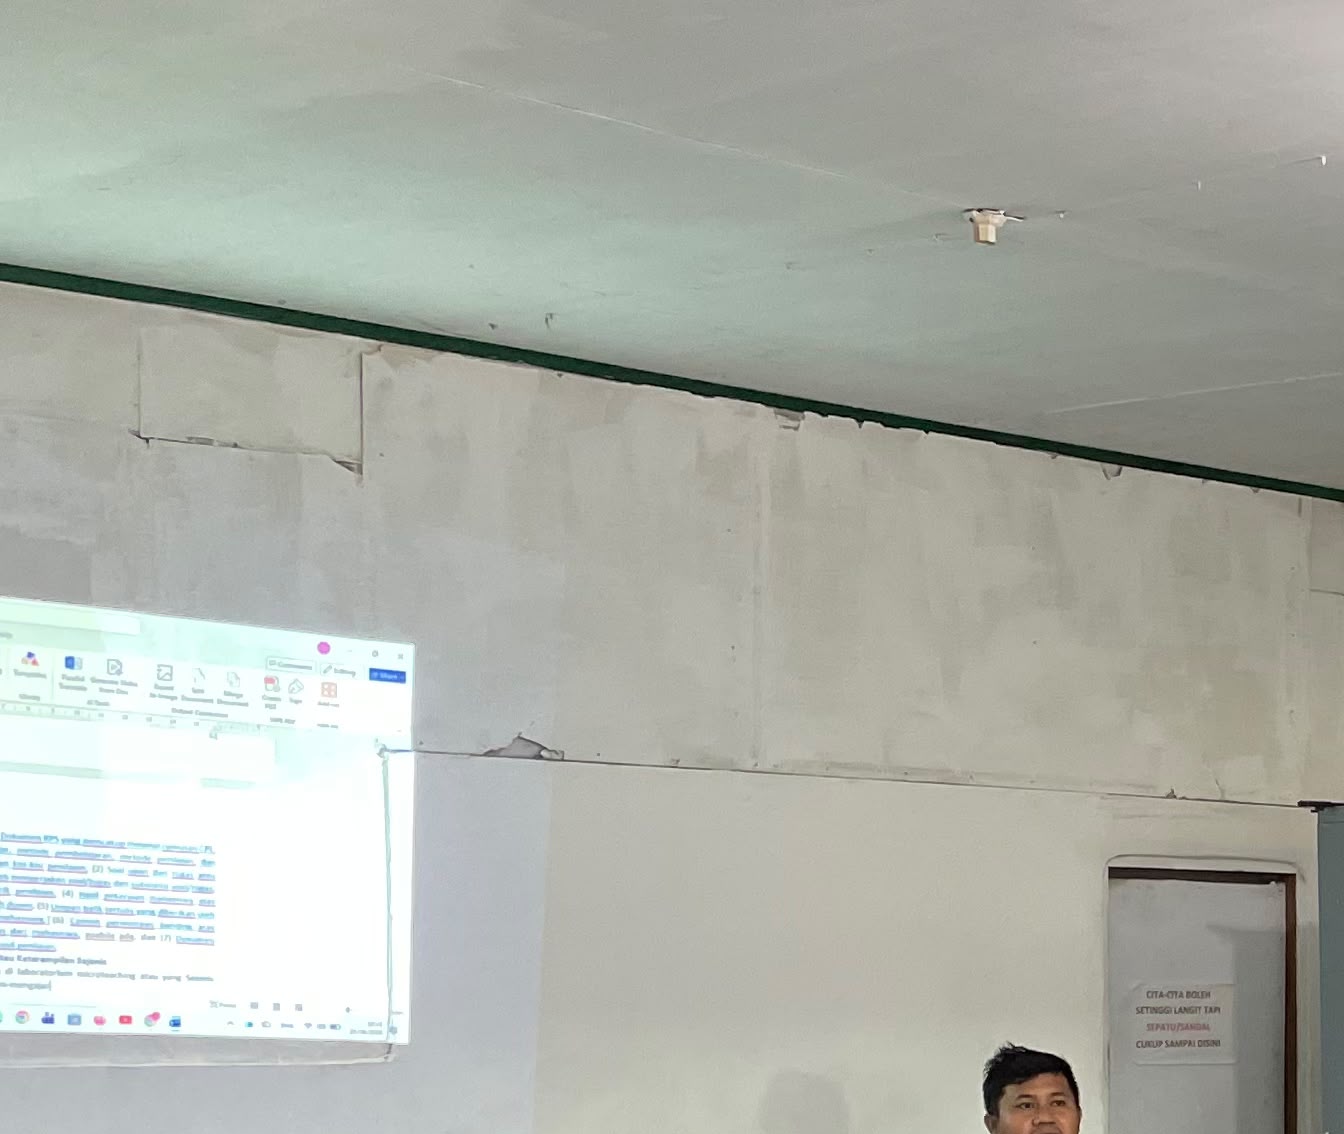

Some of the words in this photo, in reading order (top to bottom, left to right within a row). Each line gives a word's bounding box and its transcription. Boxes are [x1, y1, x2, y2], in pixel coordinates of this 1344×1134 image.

[1146, 990, 1184, 1000] CITA-CITA
[1185, 990, 1211, 999] BOLEH
[1135, 1006, 1172, 1015] SETINGGI
[1174, 1006, 1201, 1015] LANGIT
[1204, 1005, 1221, 1014] TAPI
[1146, 1022, 1211, 1032] SEPATU/SANDAL
[1135, 1040, 1163, 1049] CUKUP
[1165, 1040, 1196, 1048] SAMPAI
[1198, 1040, 1221, 1048] DISINI
